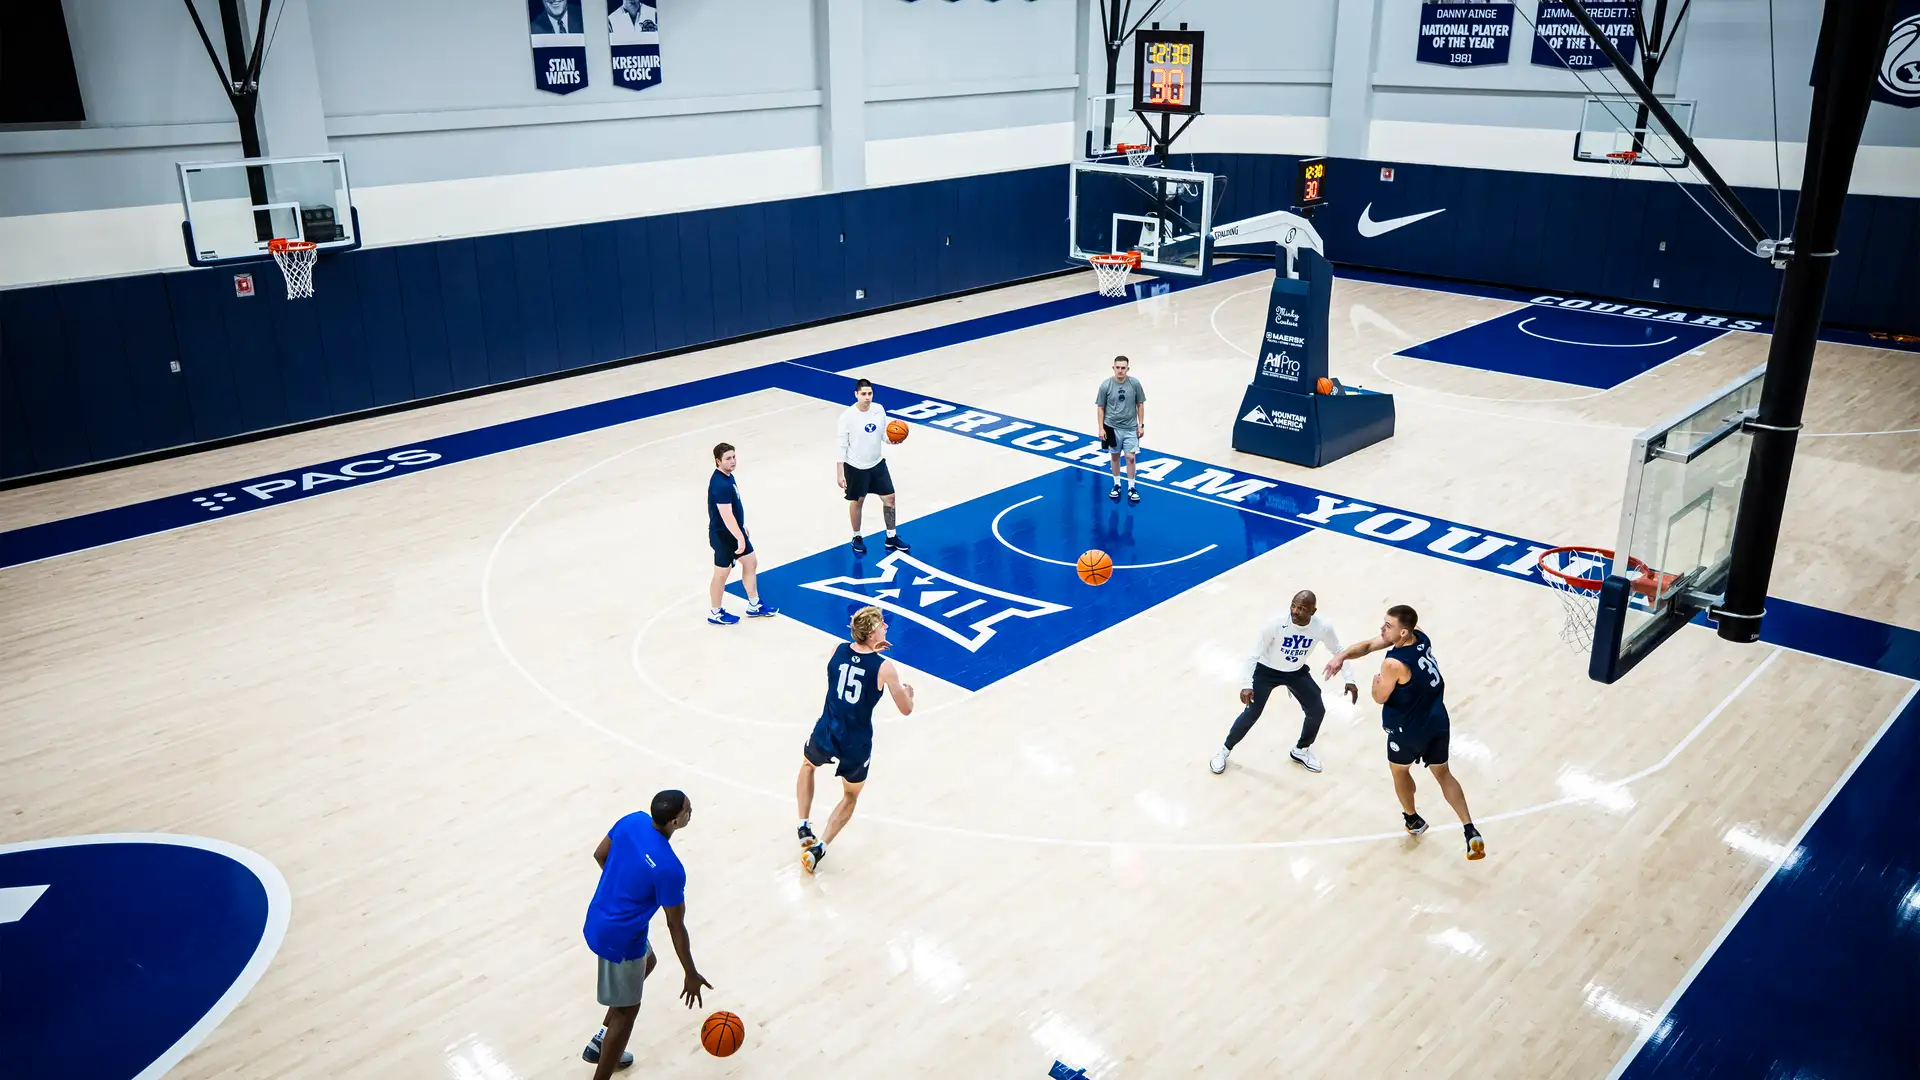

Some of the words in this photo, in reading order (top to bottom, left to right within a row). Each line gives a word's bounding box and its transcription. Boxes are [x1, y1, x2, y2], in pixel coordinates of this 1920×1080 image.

[1437, 9, 1467, 18] DANNY
[1468, 9, 1498, 18] AINGE
[1541, 8, 1575, 18] JIMM
[1422, 24, 1469, 36] NATIONAL
[1472, 24, 1510, 36] PLAYER
[1596, 24, 1635, 36] LAYER
[1433, 36, 1446, 48] OF
[1448, 37, 1466, 48] THE
[1469, 37, 1495, 49] YEAR
[1549, 37, 1564, 49] OF
[1566, 37, 1586, 49] THE
[1589, 37, 1619, 50] YR
[1152, 43, 1191, 65] 12:30
[1450, 54, 1472, 63] 1981
[1569, 55, 1593, 65] 2011
[549, 58, 575, 72] STAN
[612, 55, 661, 70] KRESIMIR
[546, 71, 580, 85] WATTS
[623, 68, 652, 81] COSIC
[1151, 67, 1185, 104] 30
[1305, 164, 1323, 179] 12:30
[1305, 181, 1318, 199] 30
[1214, 226, 1239, 240] SPALDING
[1530, 295, 1762, 331] COUGARS
[1273, 333, 1305, 344] MAERSK
[1272, 410, 1307, 423] MOUNTAIN
[1273, 418, 1303, 429] AMERICA
[241, 449, 442, 500] PACS
[887, 400, 1278, 502] BRIGHAM
[1297, 495, 1650, 606] YOUN
[1282, 635, 1313, 649] BYU
[1280, 648, 1308, 656] ENERGY
[837, 663, 865, 704] 15
